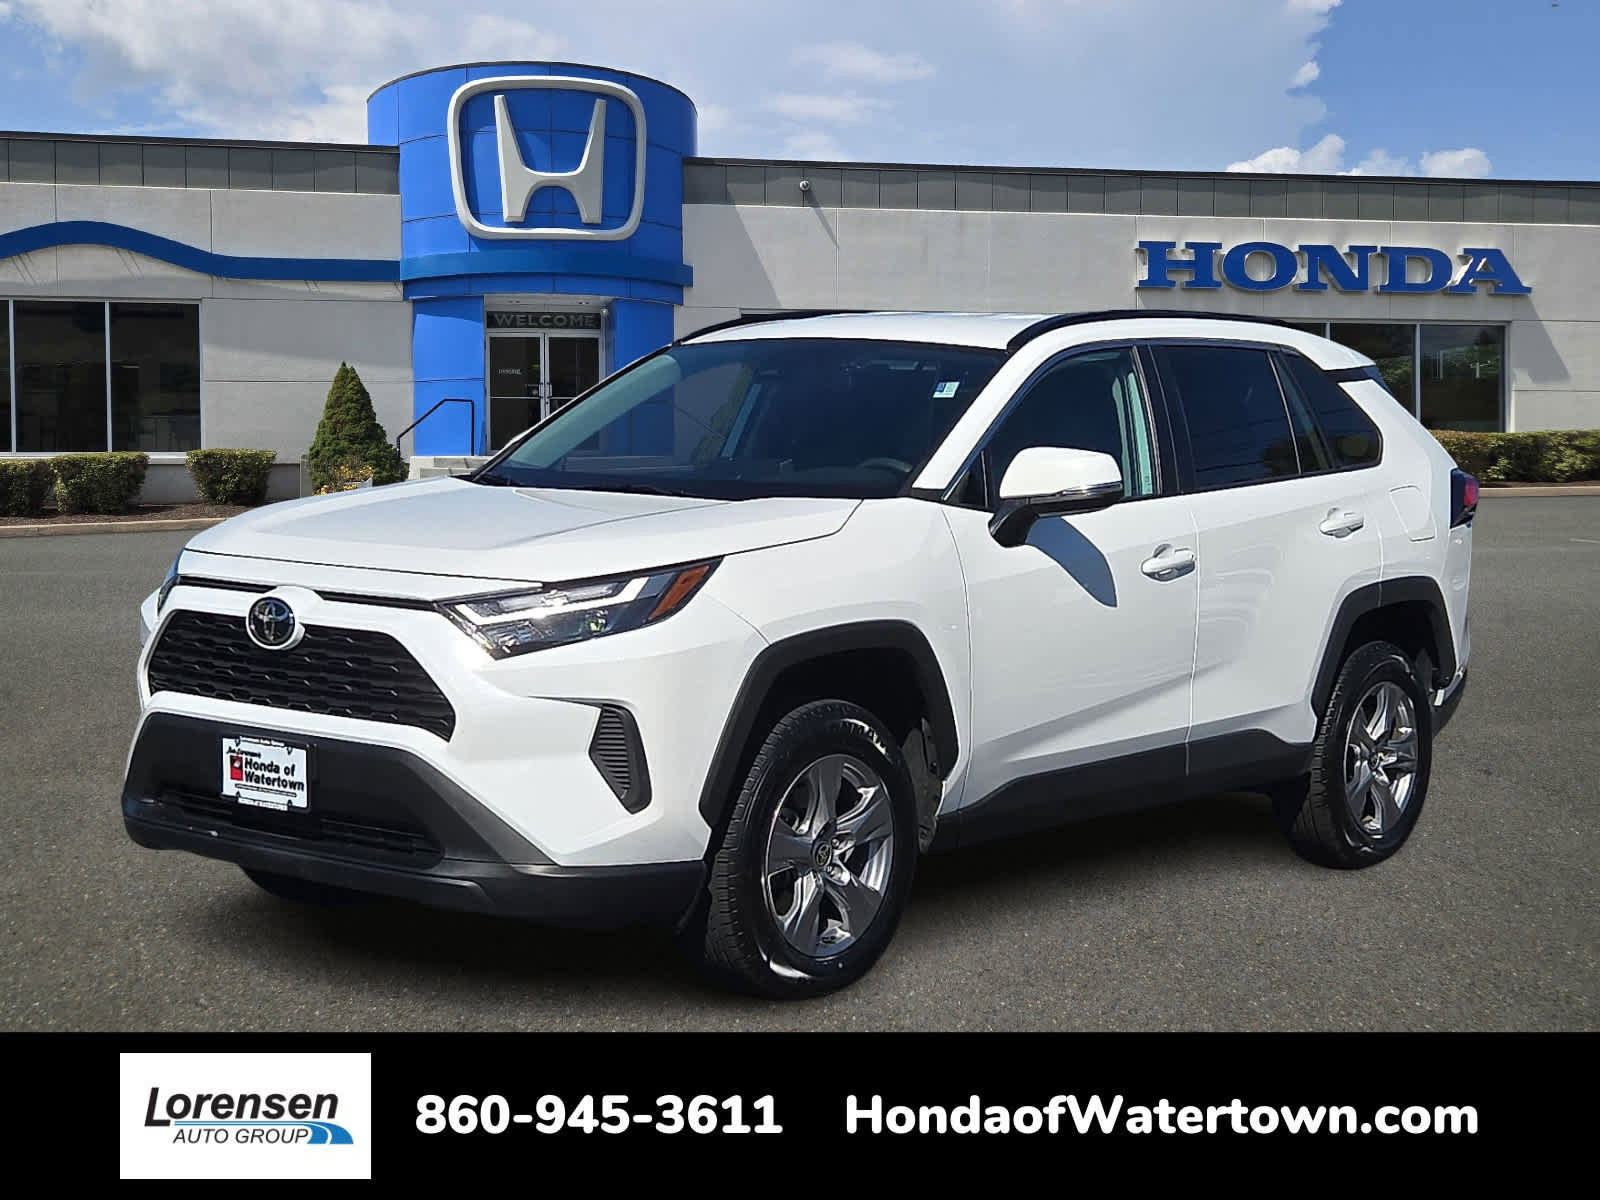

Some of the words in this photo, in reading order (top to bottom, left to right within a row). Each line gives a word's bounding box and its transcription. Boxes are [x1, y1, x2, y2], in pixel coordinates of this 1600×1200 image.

[1136, 241, 1532, 295] HONDA
[495, 312, 597, 327] WELCOME
[244, 757, 280, 774] Honda
[283, 763, 296, 777] of
[244, 770, 305, 792] Watertown
